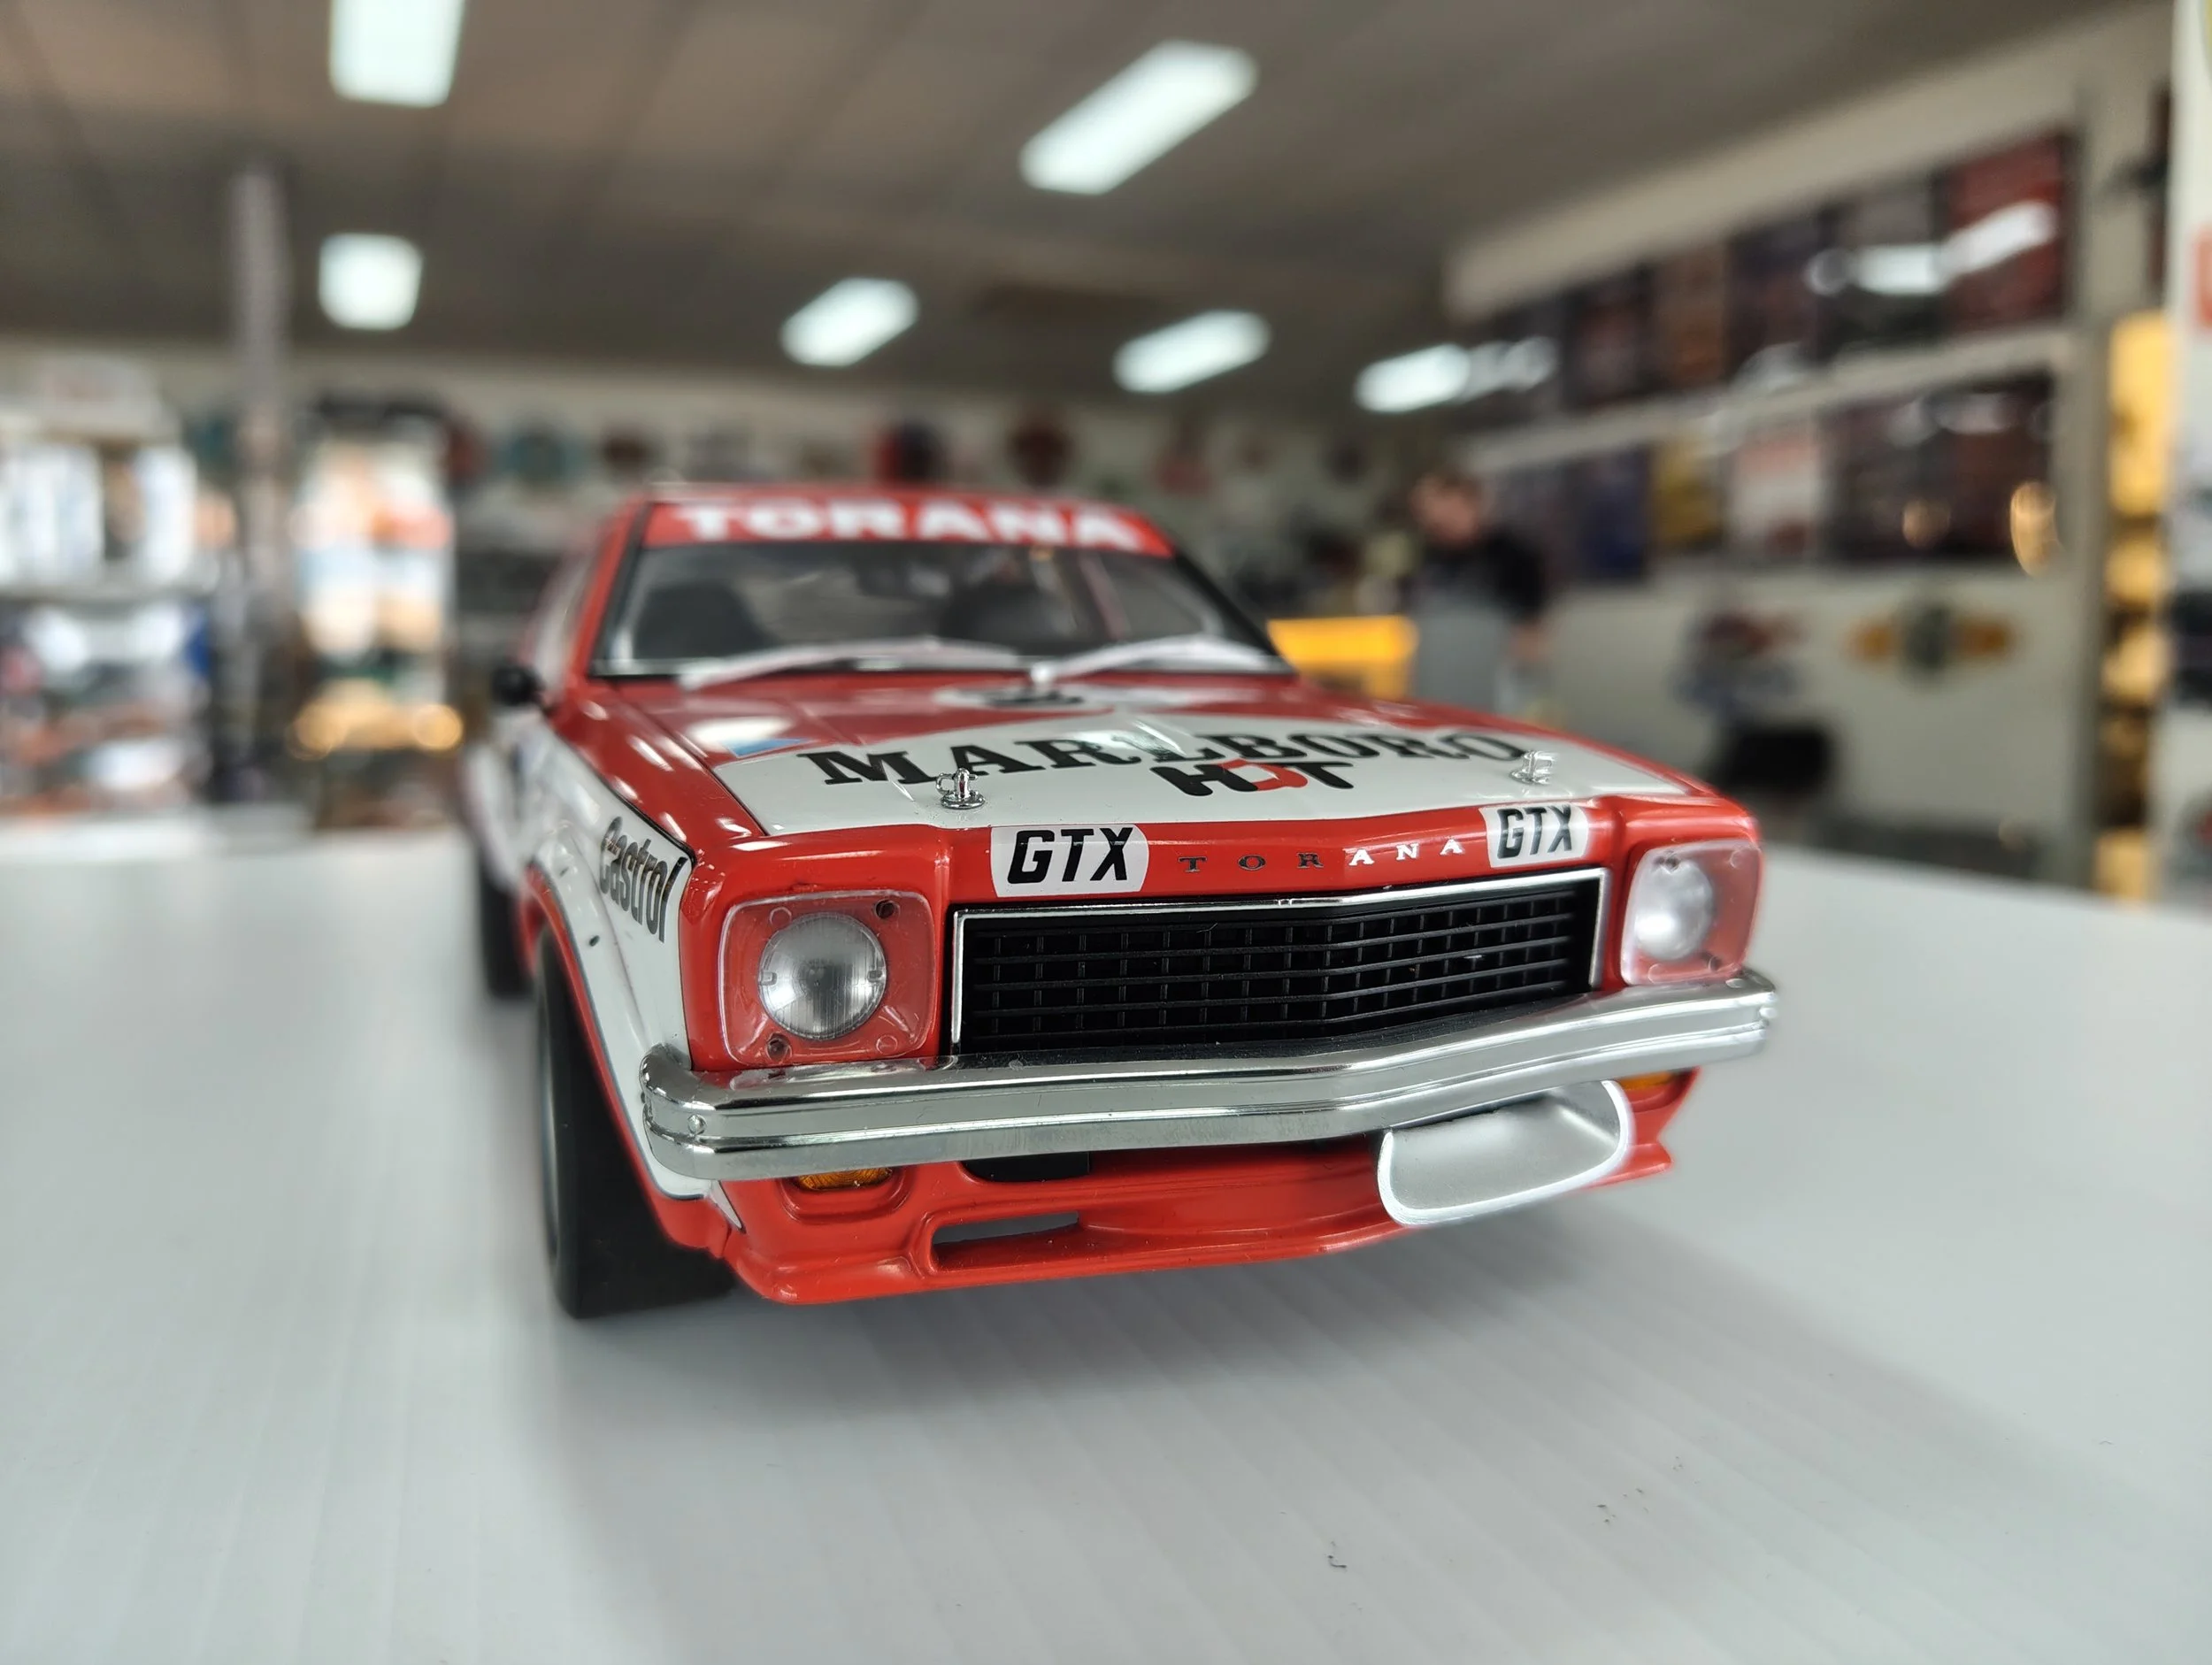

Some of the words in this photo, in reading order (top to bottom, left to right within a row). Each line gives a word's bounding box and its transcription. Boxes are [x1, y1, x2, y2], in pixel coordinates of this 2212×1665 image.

[678, 500, 1141, 549] TORANA
[796, 733, 1528, 786] MARLBORO
[1007, 826, 1134, 885] GTX
[1179, 839, 1463, 873] TORANA
[1495, 803, 1574, 859] GTX
[599, 816, 688, 944] Castrol
